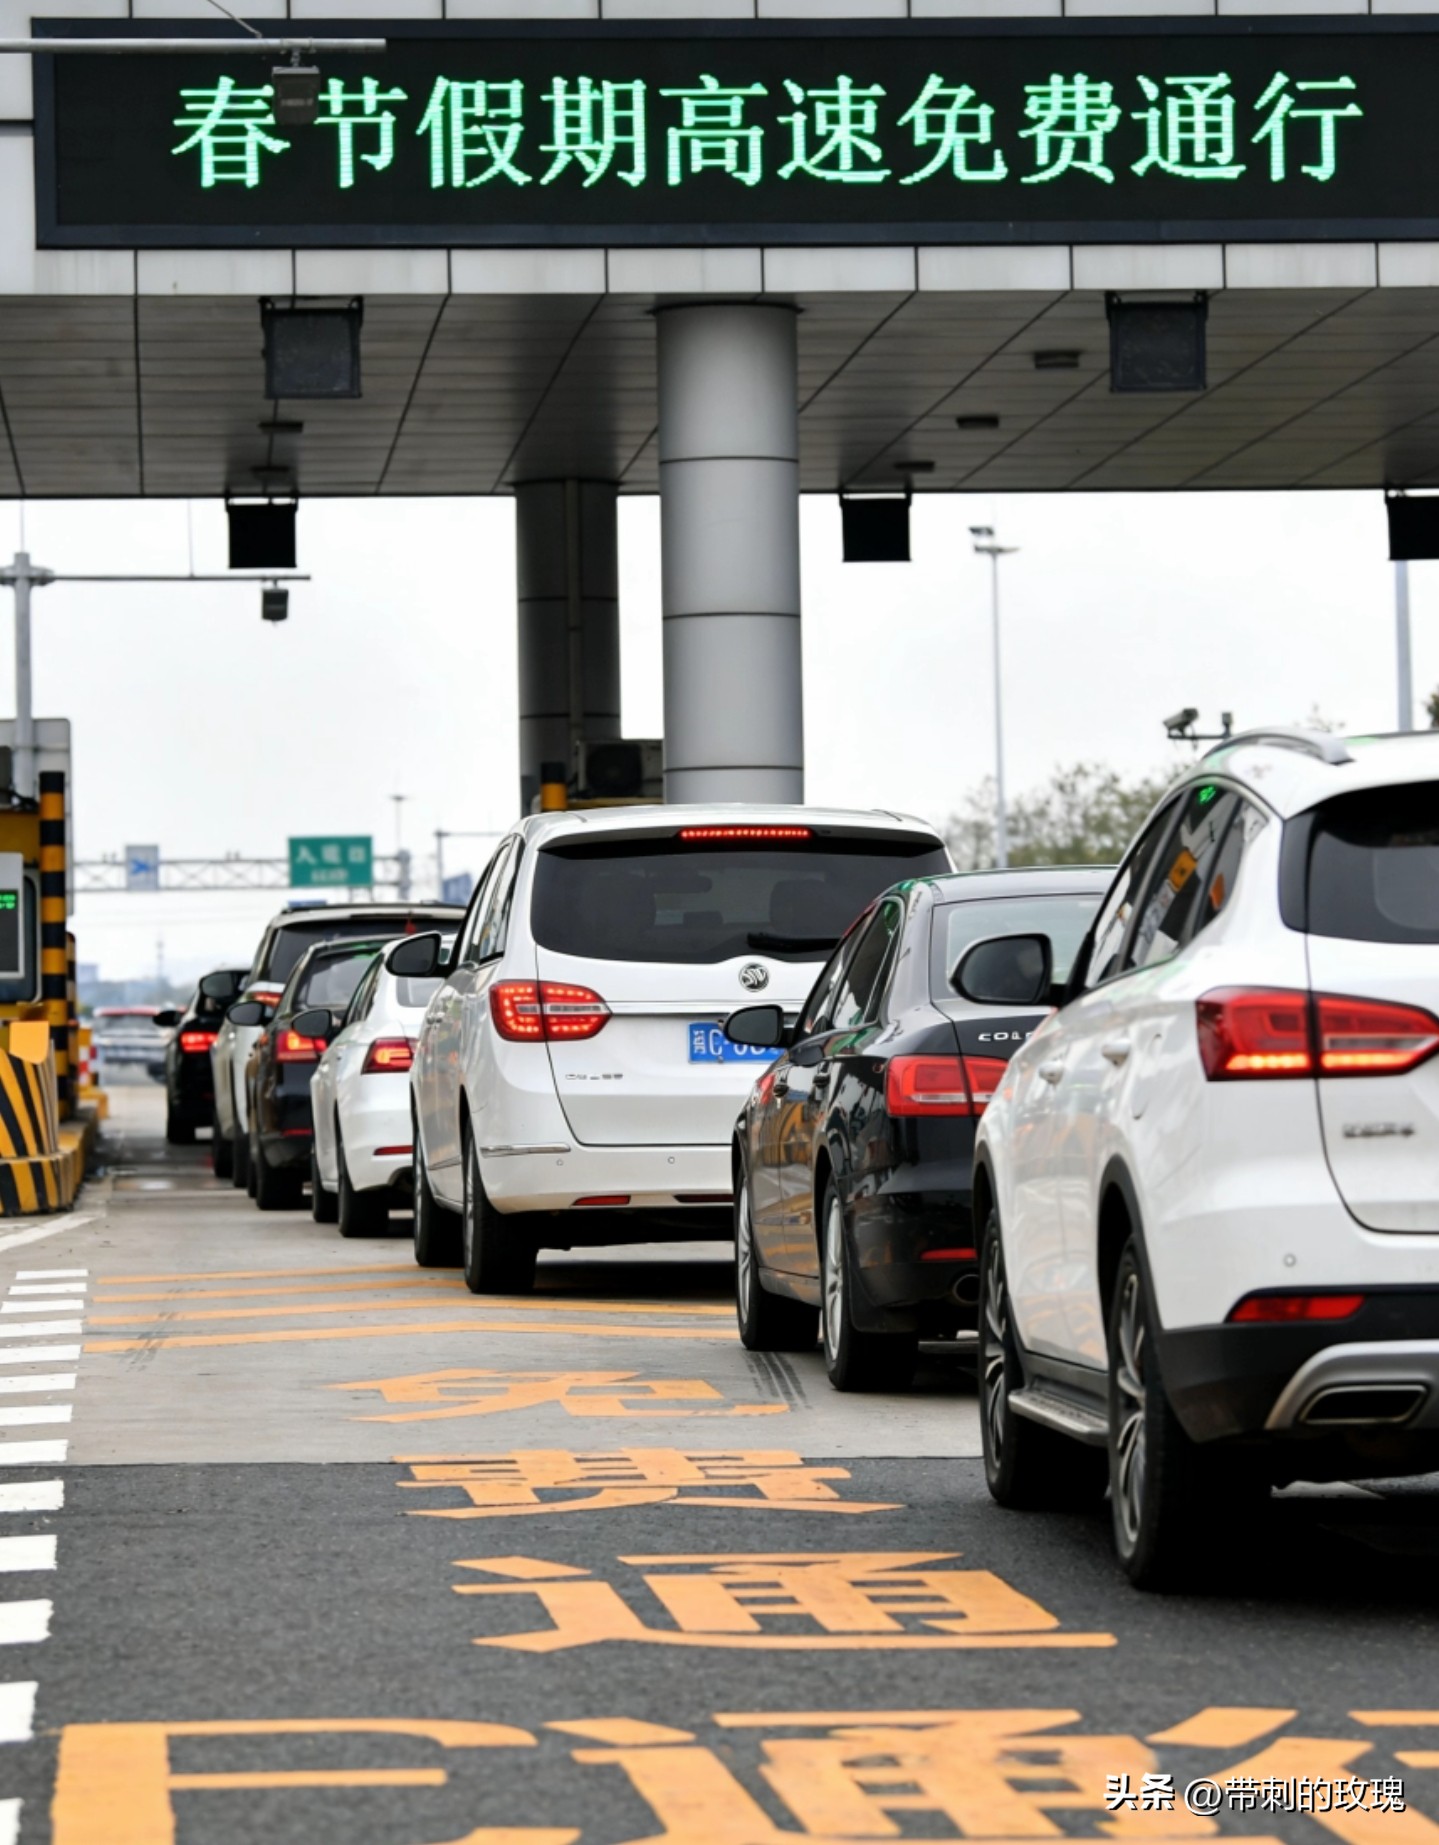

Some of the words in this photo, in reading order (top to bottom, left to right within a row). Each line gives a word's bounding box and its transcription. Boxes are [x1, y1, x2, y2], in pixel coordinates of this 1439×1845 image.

[171, 72, 1363, 188] 春节假期高速免费通行
